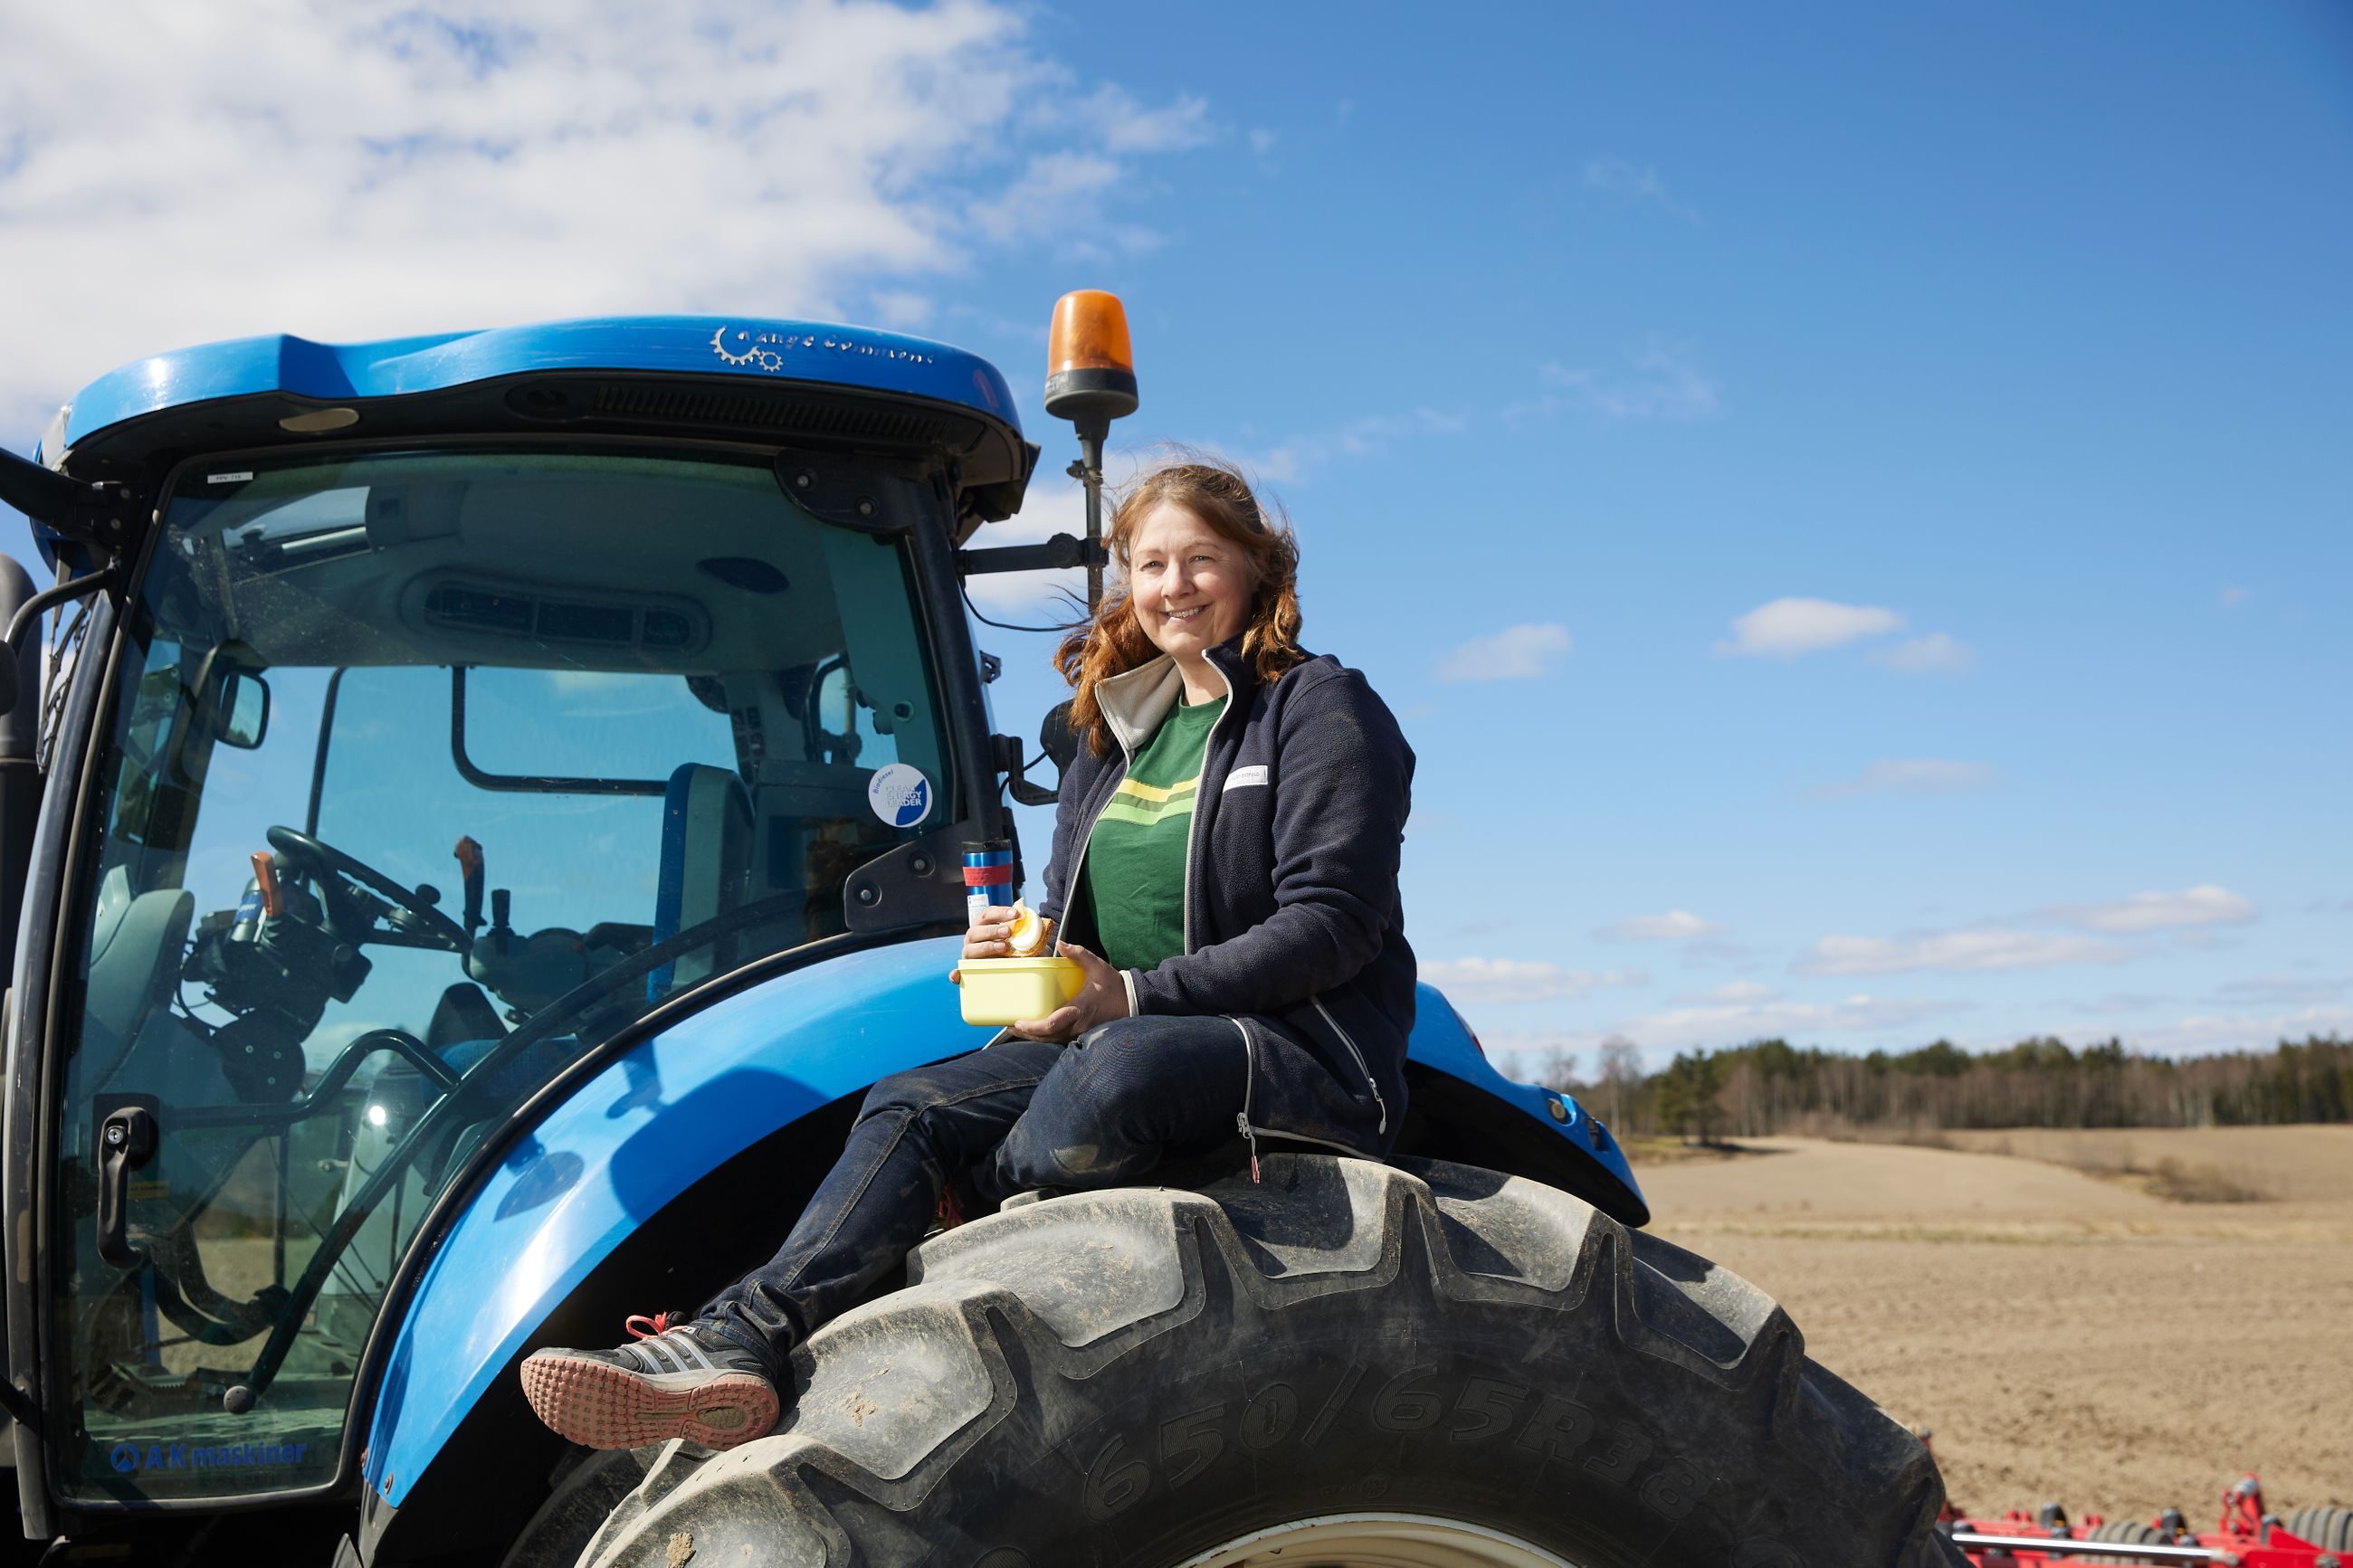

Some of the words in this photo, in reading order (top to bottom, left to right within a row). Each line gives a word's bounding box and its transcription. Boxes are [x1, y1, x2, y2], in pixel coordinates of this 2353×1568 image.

[872, 768, 894, 794] Biodiesel
[1081, 1358, 1711, 1522] 650/65R38
[192, 1441, 309, 1468] maskiner
